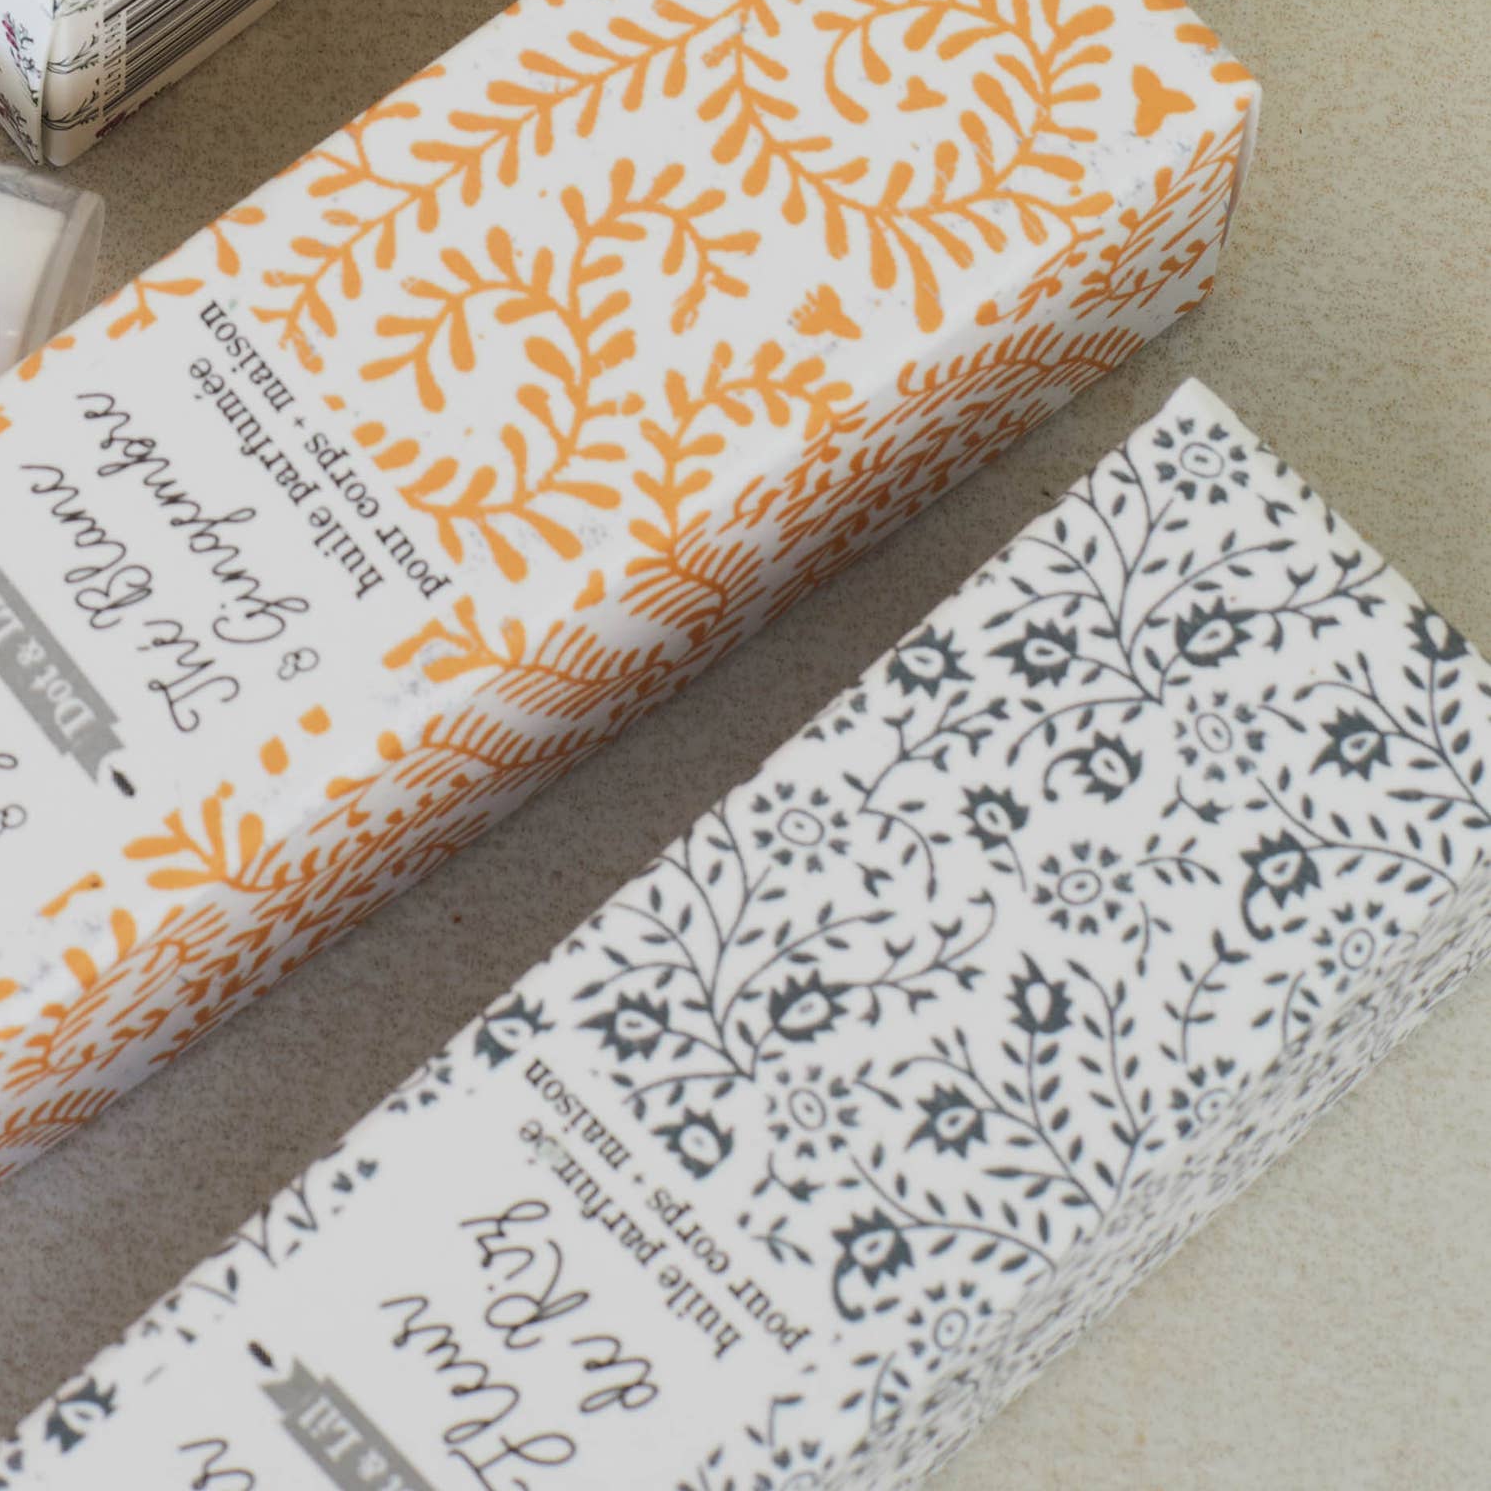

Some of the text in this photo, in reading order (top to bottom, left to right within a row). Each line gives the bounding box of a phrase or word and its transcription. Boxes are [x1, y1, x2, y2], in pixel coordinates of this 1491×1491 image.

[75, 392, 321, 682] & Gingembre
[188, 357, 386, 601] huile parfumée
[199, 299, 453, 601] pour corps maison
[19, 464, 241, 734] Thé Blanc
[32, 666, 97, 740] Dot
[458, 1199, 661, 1416] de Riz
[523, 1057, 813, 1354] pour corps maison
[658, 1265, 743, 1361] huile
[298, 1395, 363, 1464] Lil
